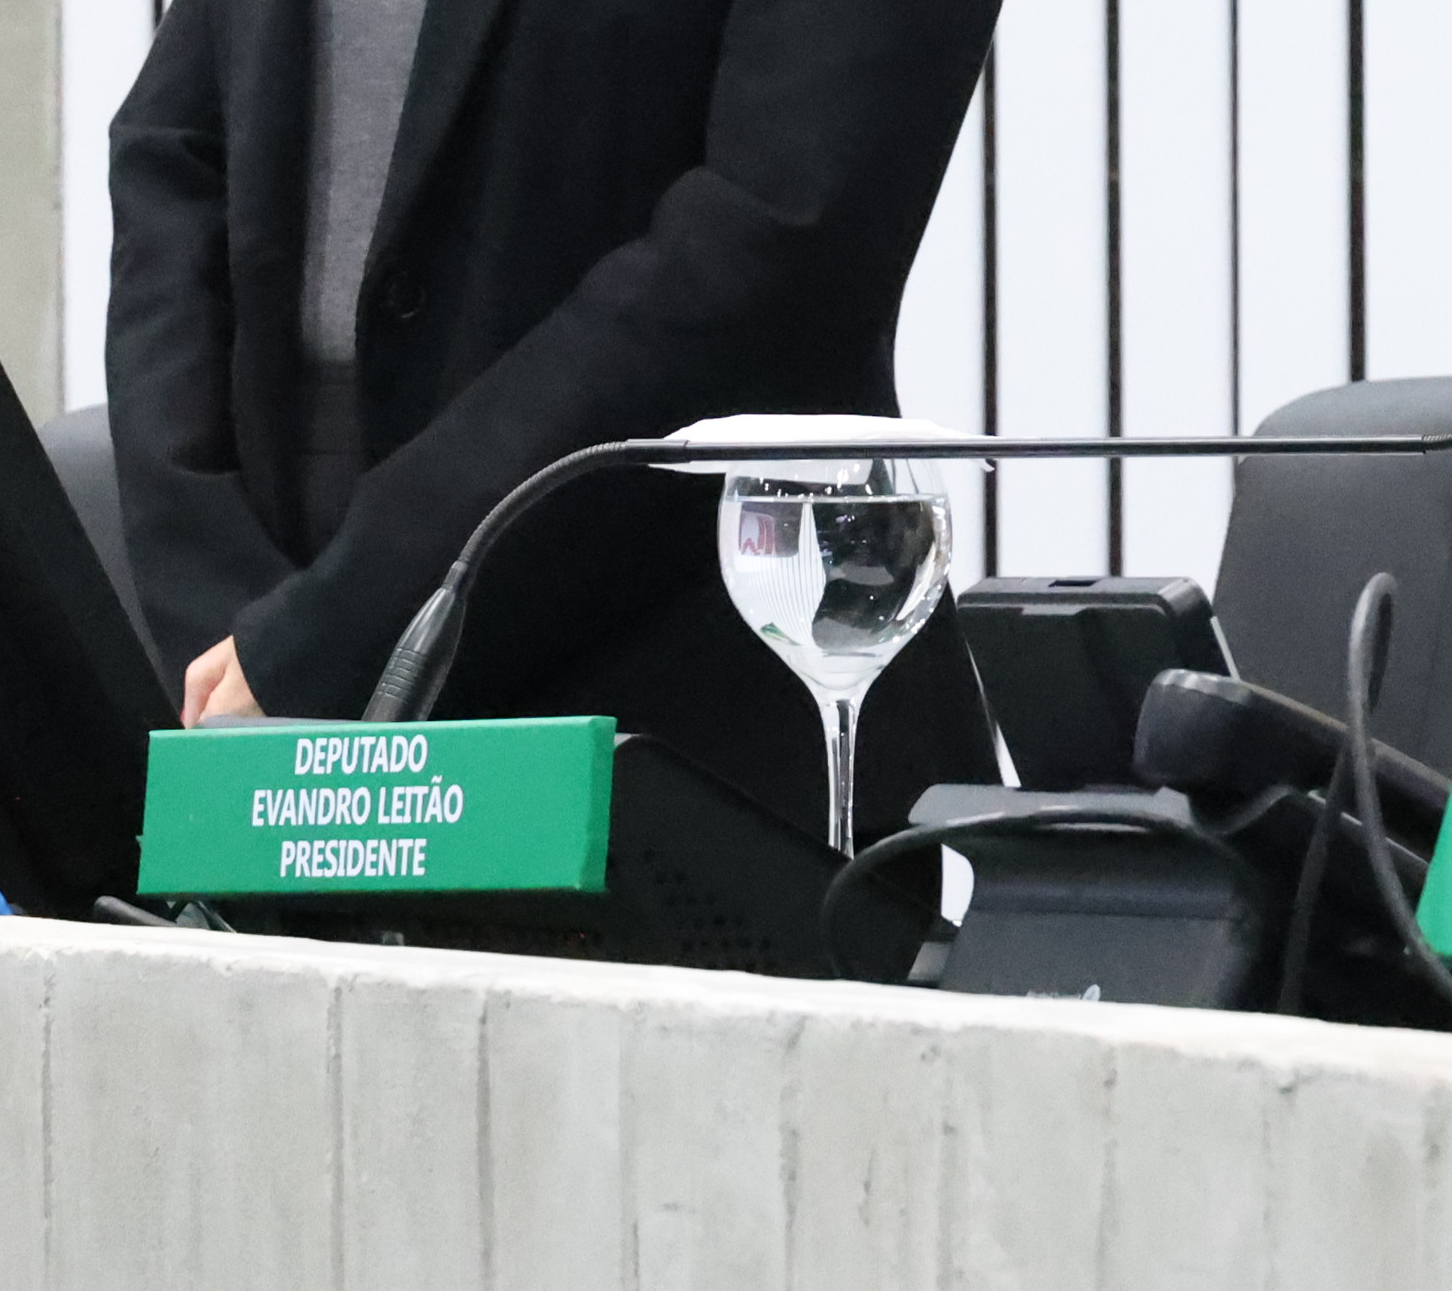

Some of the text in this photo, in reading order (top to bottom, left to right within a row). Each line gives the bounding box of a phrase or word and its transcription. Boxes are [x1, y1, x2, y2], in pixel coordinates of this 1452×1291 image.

[294, 734, 428, 775] DEPUTADO
[251, 775, 464, 827] EVANDRO LEITÃO
[280, 838, 427, 878] PRESIDENTE
